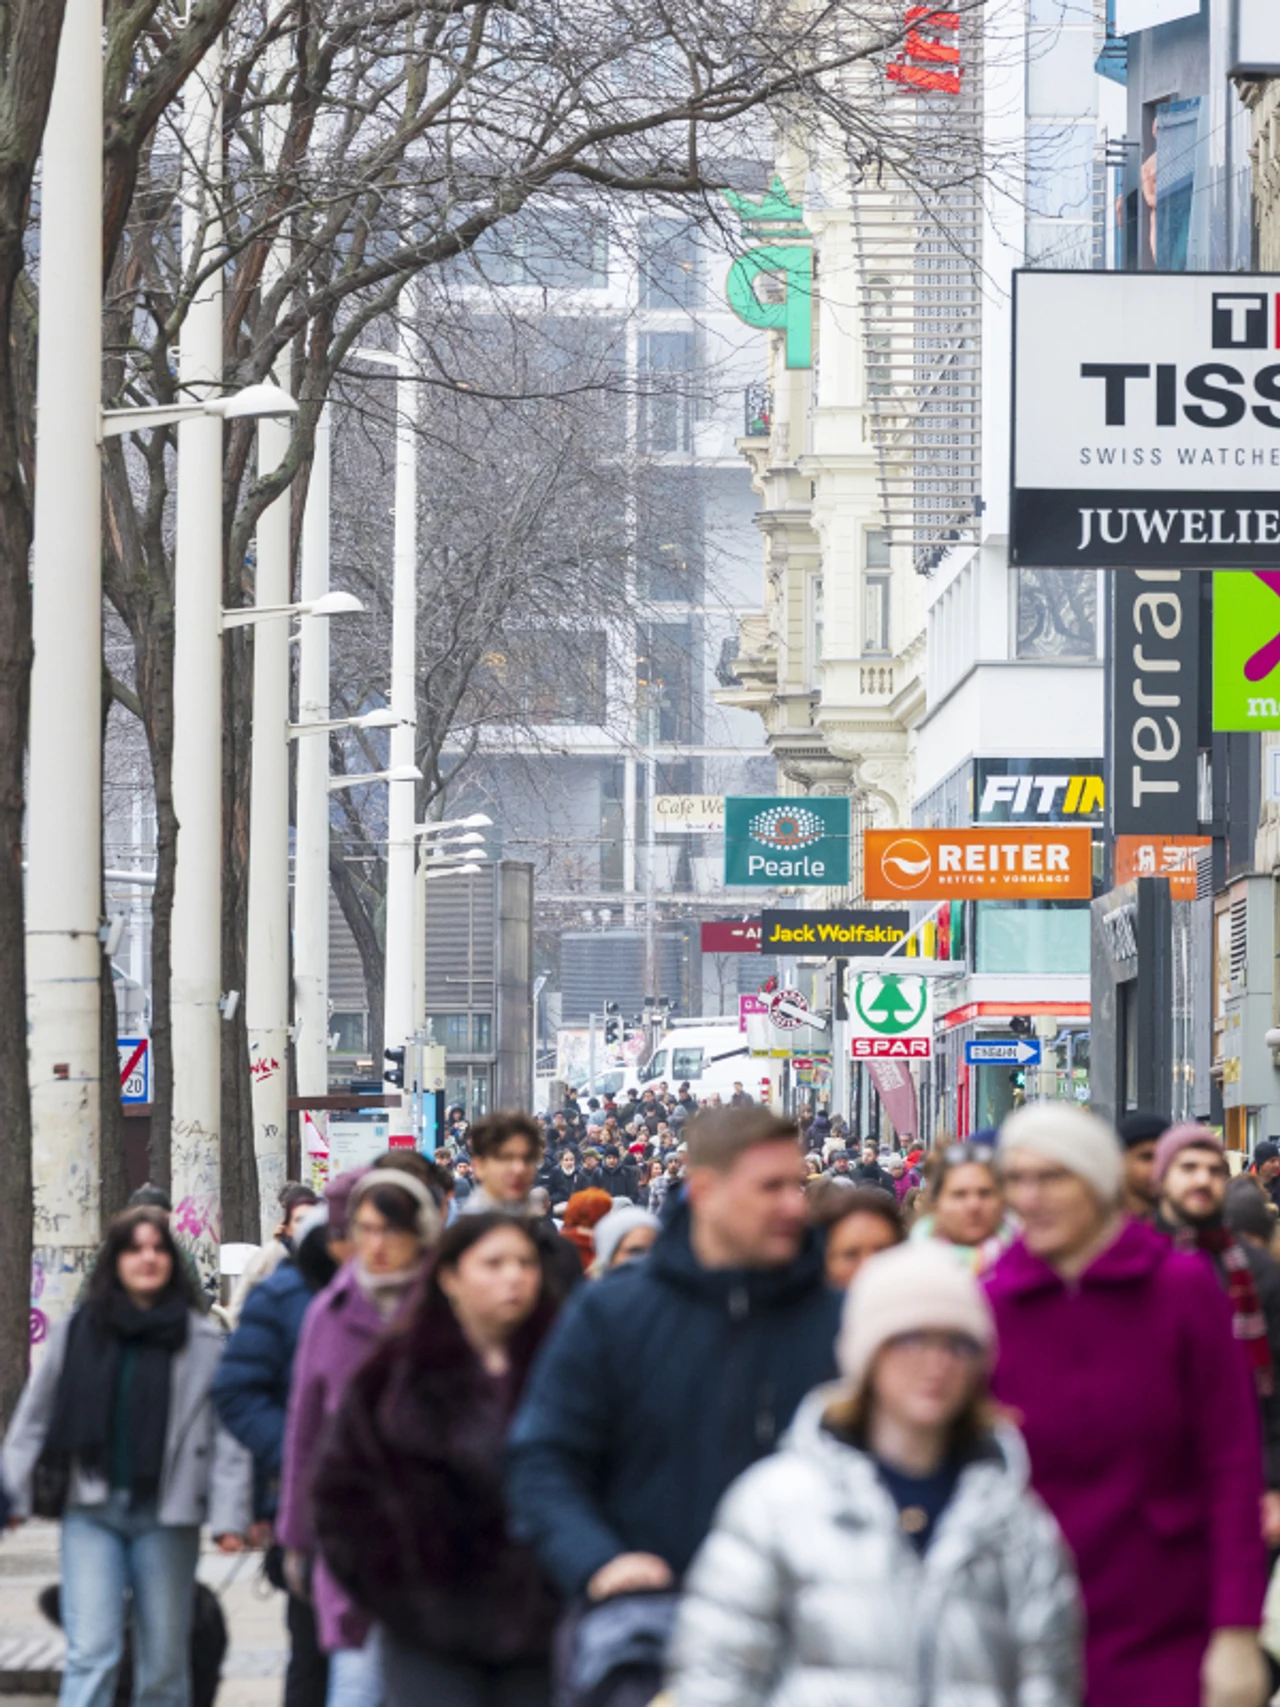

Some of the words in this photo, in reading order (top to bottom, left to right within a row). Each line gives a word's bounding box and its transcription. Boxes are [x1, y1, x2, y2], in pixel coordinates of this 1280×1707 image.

[1080, 447, 1162, 466] SWISS
[1132, 570, 1182, 808] Terra
[748, 855, 825, 877] Pearle
[938, 843, 1071, 872] REITER
[939, 875, 984, 884] BETTEN
[1003, 873, 1070, 883] VORHÄNGE
[769, 923, 815, 942] Jack
[817, 923, 904, 943] Wolfskin
[855, 1040, 927, 1055] SPAR
[126, 1078, 142, 1094] 20
